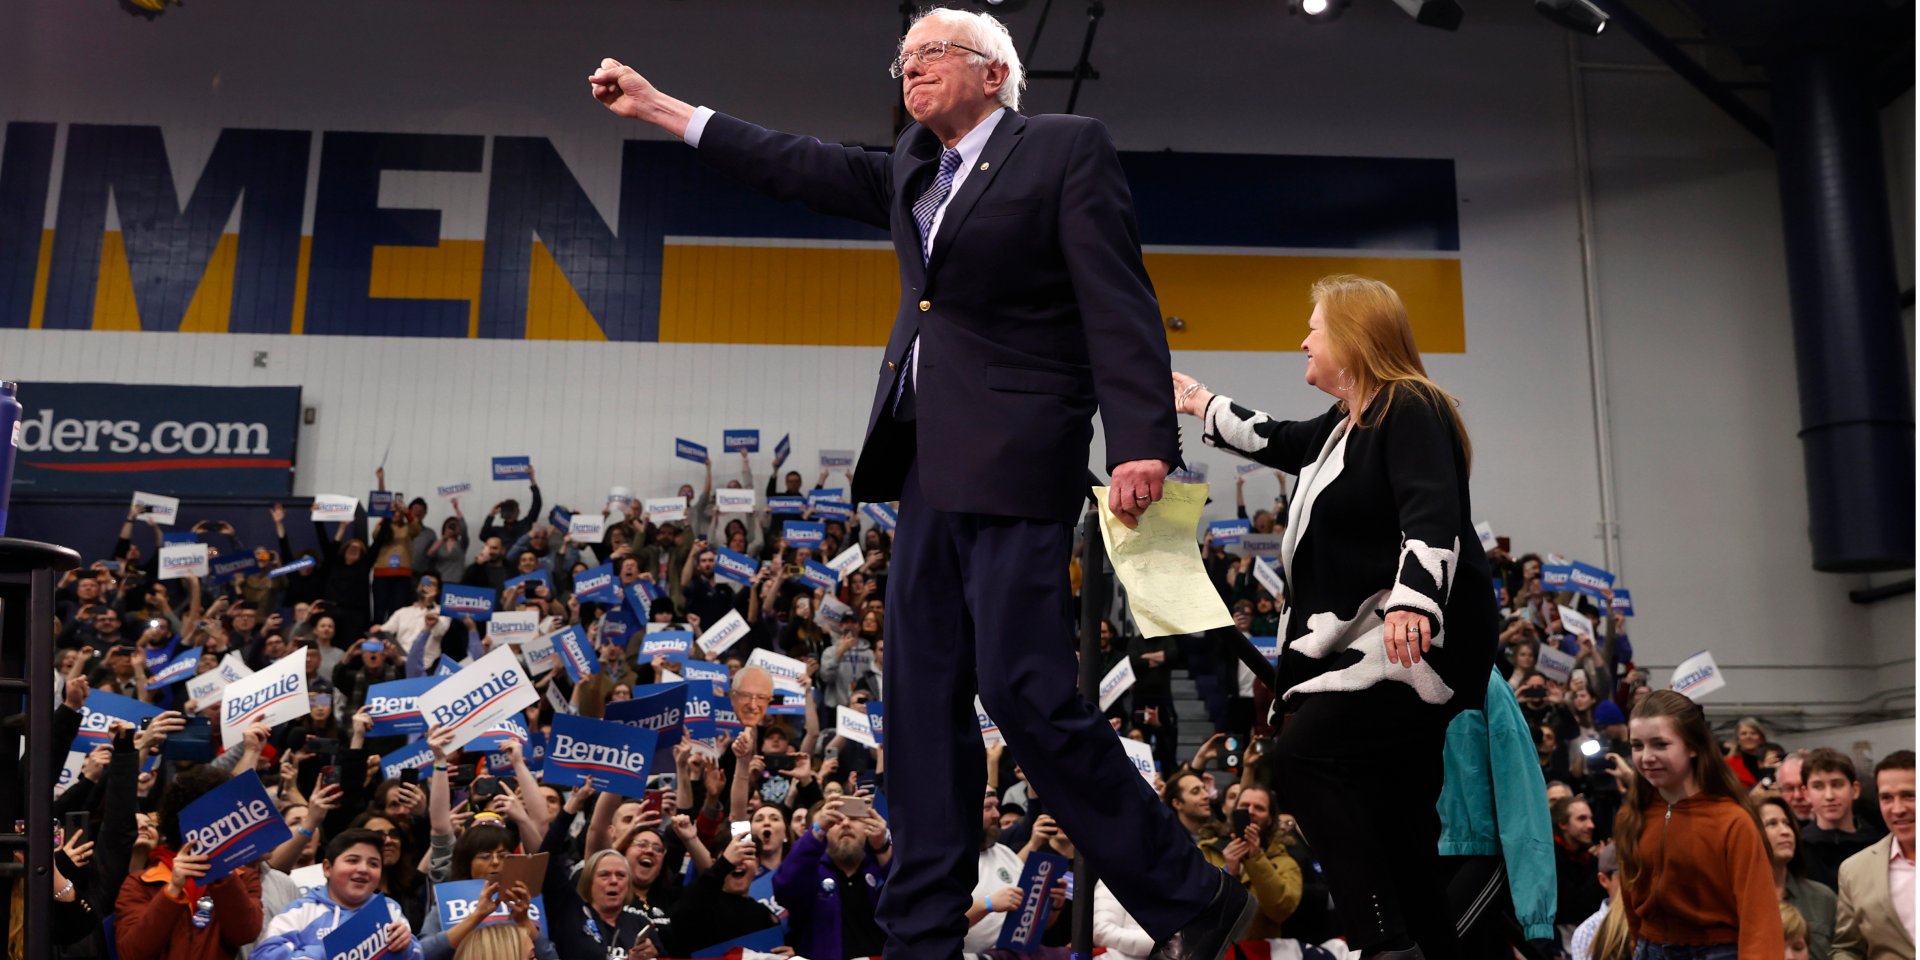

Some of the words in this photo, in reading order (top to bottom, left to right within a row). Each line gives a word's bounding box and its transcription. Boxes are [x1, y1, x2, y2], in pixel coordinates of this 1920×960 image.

[726, 436, 757, 446] Bernie
[821, 455, 853, 466] Bernie
[437, 482, 471, 495] Bernie
[649, 503, 684, 512] Bernie
[719, 495, 752, 505] Bernie
[786, 529, 822, 540] Bernie
[1211, 525, 1249, 536] Bernie
[1243, 539, 1280, 550] Bernie
[162, 554, 204, 568] Bernie
[215, 558, 255, 575] Bernie
[718, 555, 754, 575] Bernie
[575, 573, 611, 594] Bernie
[804, 565, 837, 586] Bernie
[1570, 569, 1609, 589] Bernie
[444, 593, 492, 611] Bernie
[490, 621, 535, 633] Bernie
[703, 619, 742, 649] Bernie
[562, 632, 591, 674] Bernie
[644, 638, 687, 652] Bernie
[760, 660, 800, 678] Bernie
[1540, 653, 1573, 674] Bernie
[686, 667, 727, 684] Bernie
[227, 672, 299, 721] Bernie
[431, 669, 519, 727] Bernie
[611, 707, 680, 731] rnie
[552, 734, 645, 773] Bernie
[384, 749, 434, 779] Bernie
[185, 799, 269, 855] Bernie
[1011, 861, 1052, 944] Bernie
